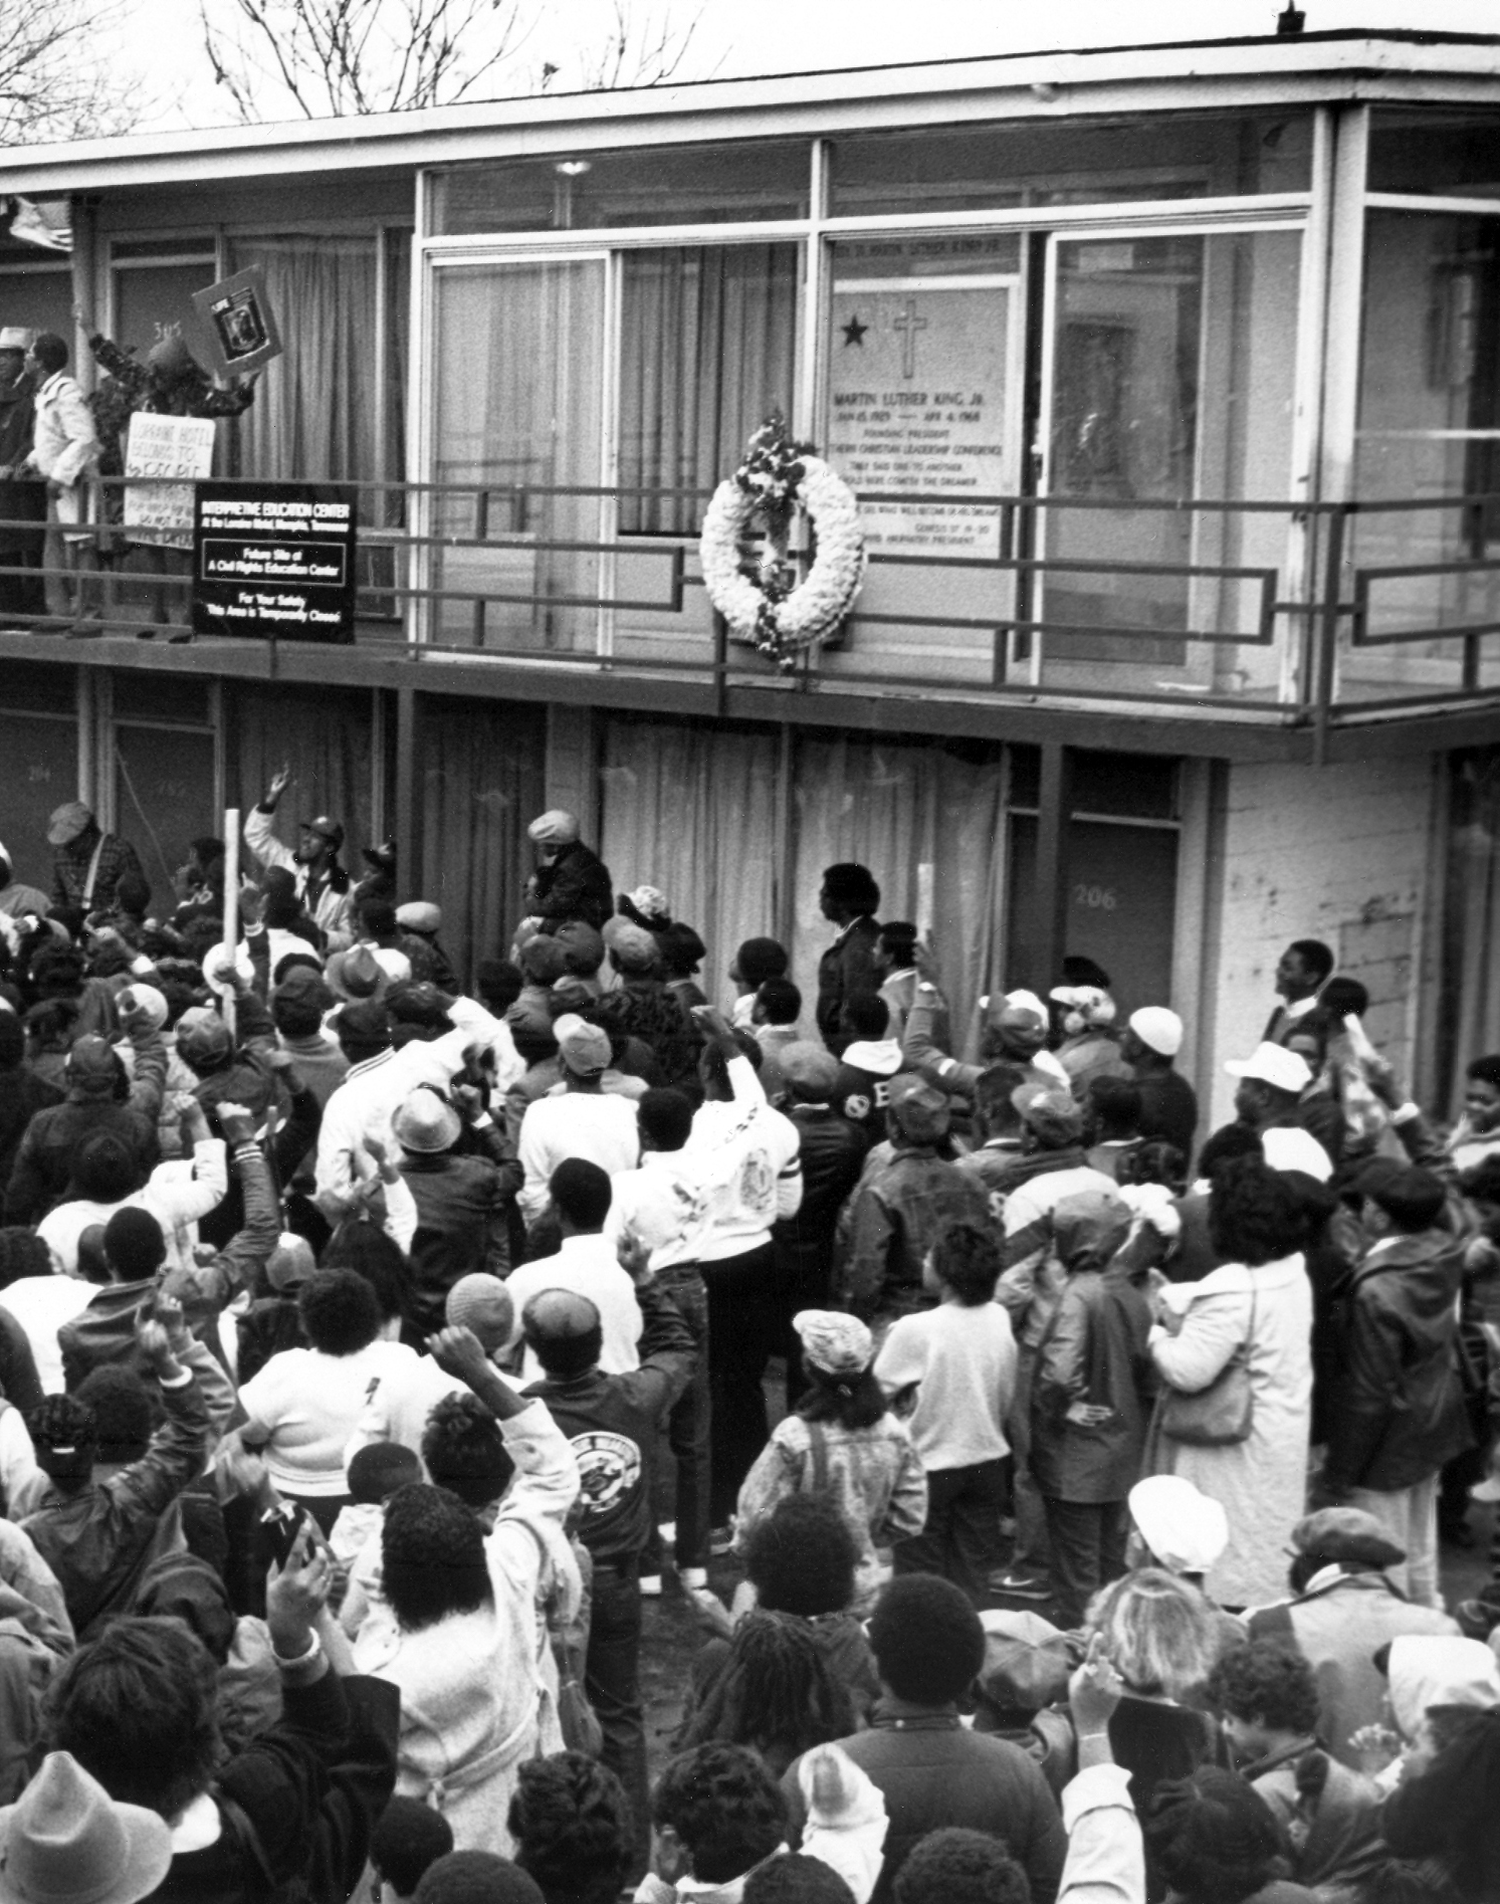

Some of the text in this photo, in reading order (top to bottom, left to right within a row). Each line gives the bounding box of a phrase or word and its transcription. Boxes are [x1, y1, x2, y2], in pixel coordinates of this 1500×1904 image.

[834, 391, 877, 407] MARTIN
[882, 391, 929, 407] LUTHER
[202, 501, 262, 516] INTERPRETIVE
[263, 502, 313, 517] EDUCATION
[313, 503, 350, 518] CENTER
[243, 548, 303, 561] Future Site of
[208, 560, 216, 571] A
[236, 560, 264, 575] Rights
[264, 562, 308, 575] Education
[309, 563, 339, 576] Center
[238, 592, 307, 609] For Your Safety
[206, 603, 225, 616] This
[226, 605, 247, 617] Area
[248, 606, 257, 617] is
[1072, 884, 1118, 911] 206
